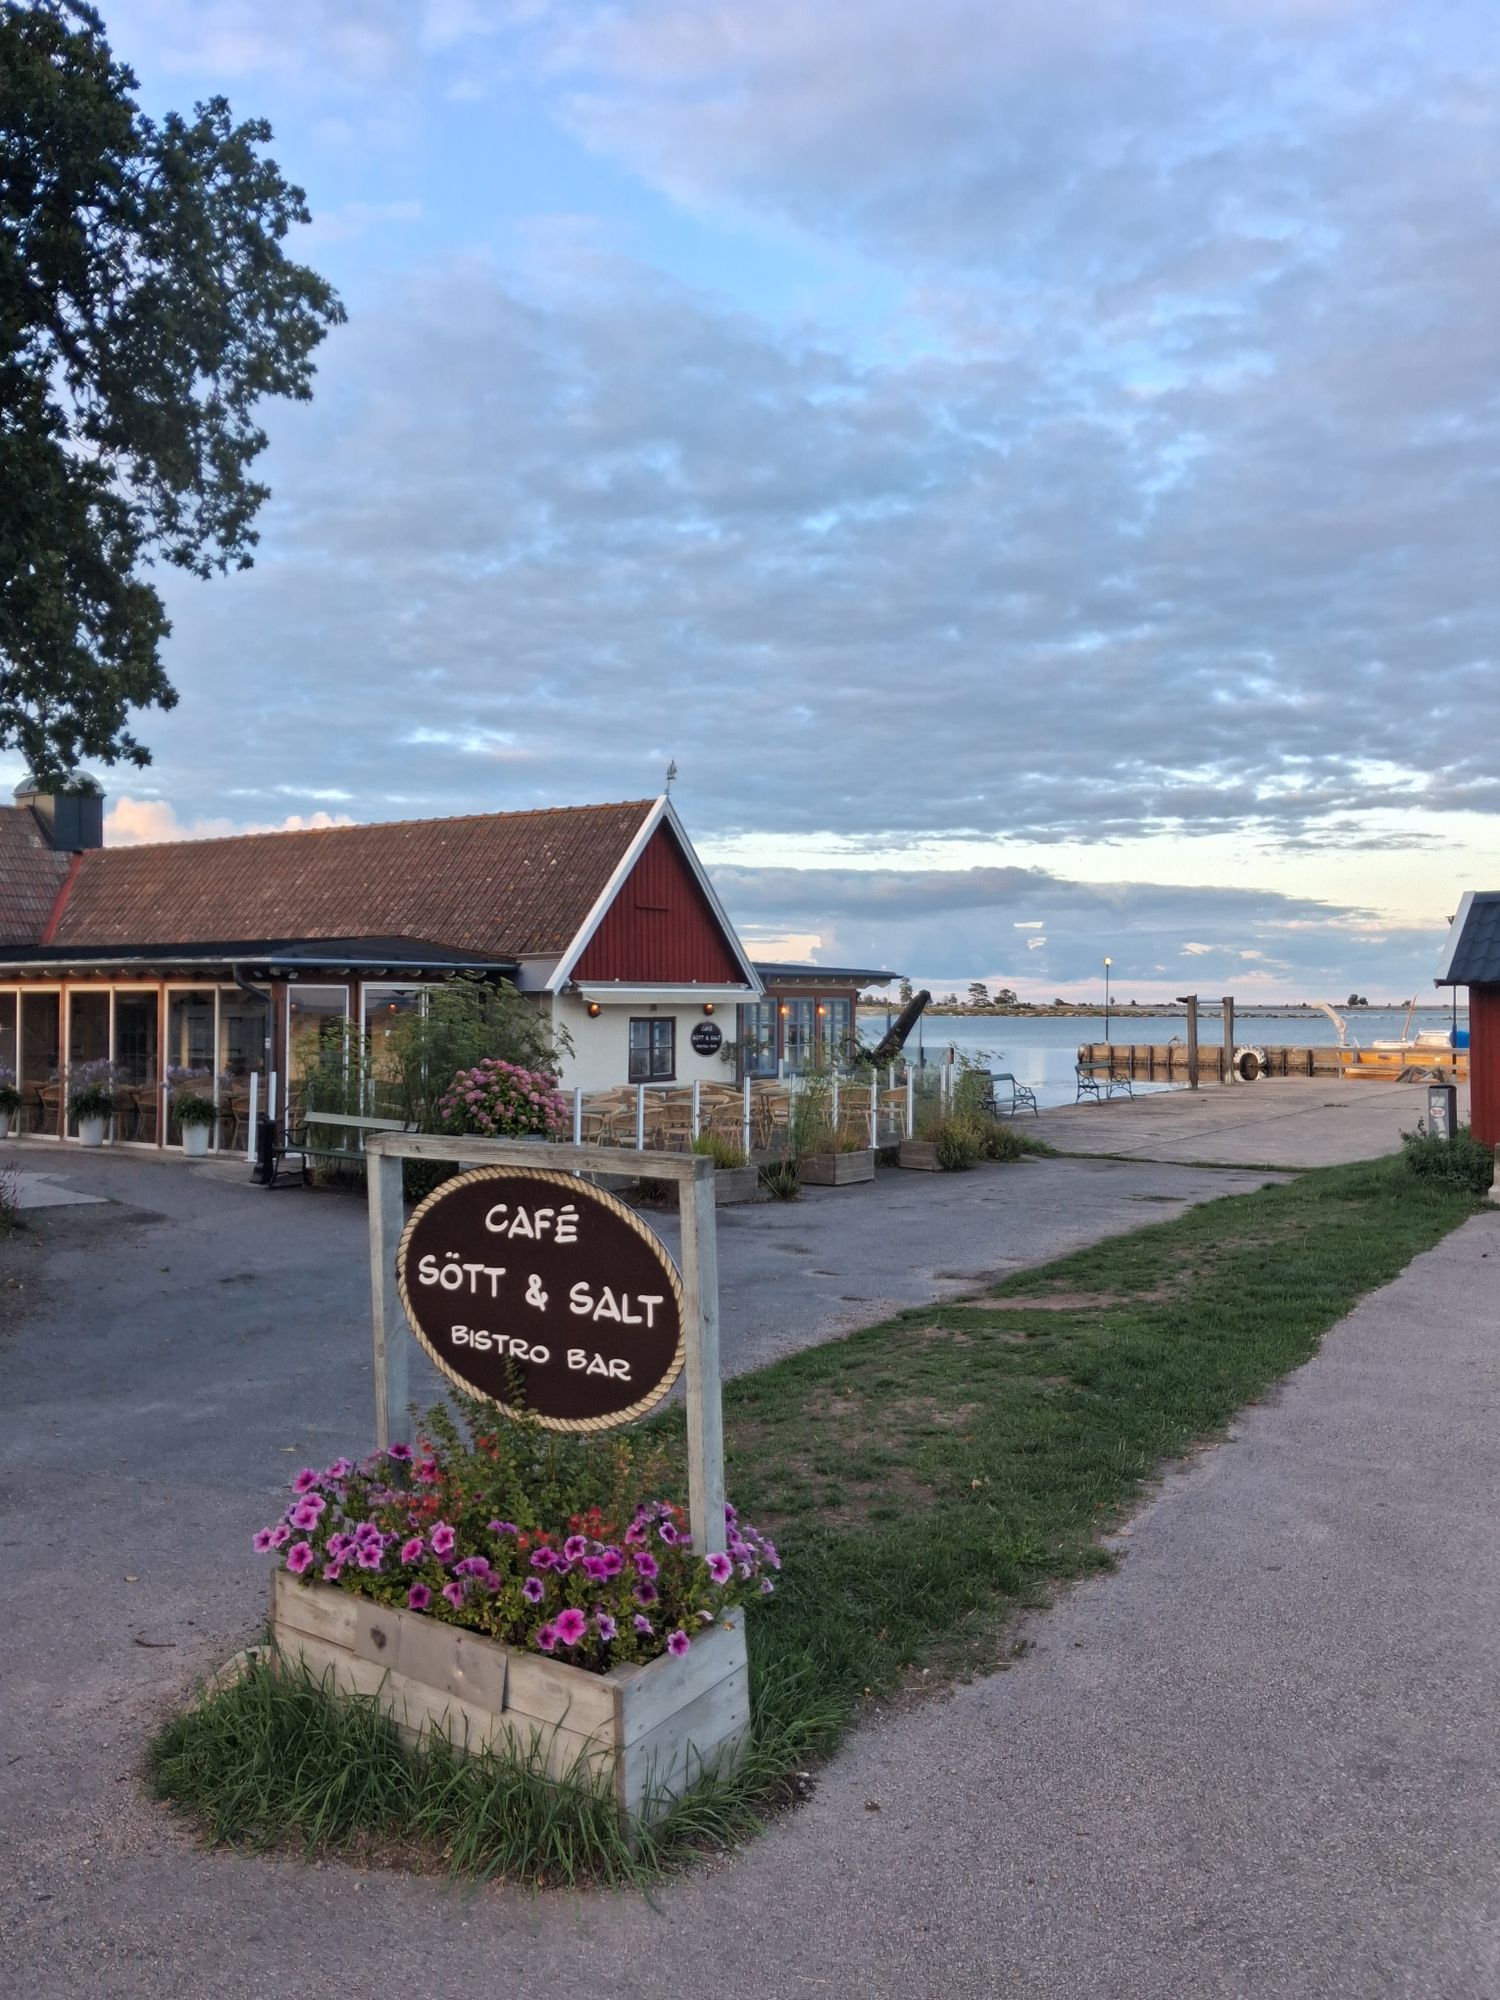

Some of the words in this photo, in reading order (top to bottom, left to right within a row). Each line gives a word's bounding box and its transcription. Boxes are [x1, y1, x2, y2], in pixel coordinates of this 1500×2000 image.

[485, 1204, 580, 1244] CAFÉ
[418, 1252, 507, 1298] SÖTT
[525, 1274, 549, 1312] &
[569, 1282, 664, 1329] SALT
[451, 1325, 550, 1364] BISTRO
[567, 1349, 632, 1381] BAR
